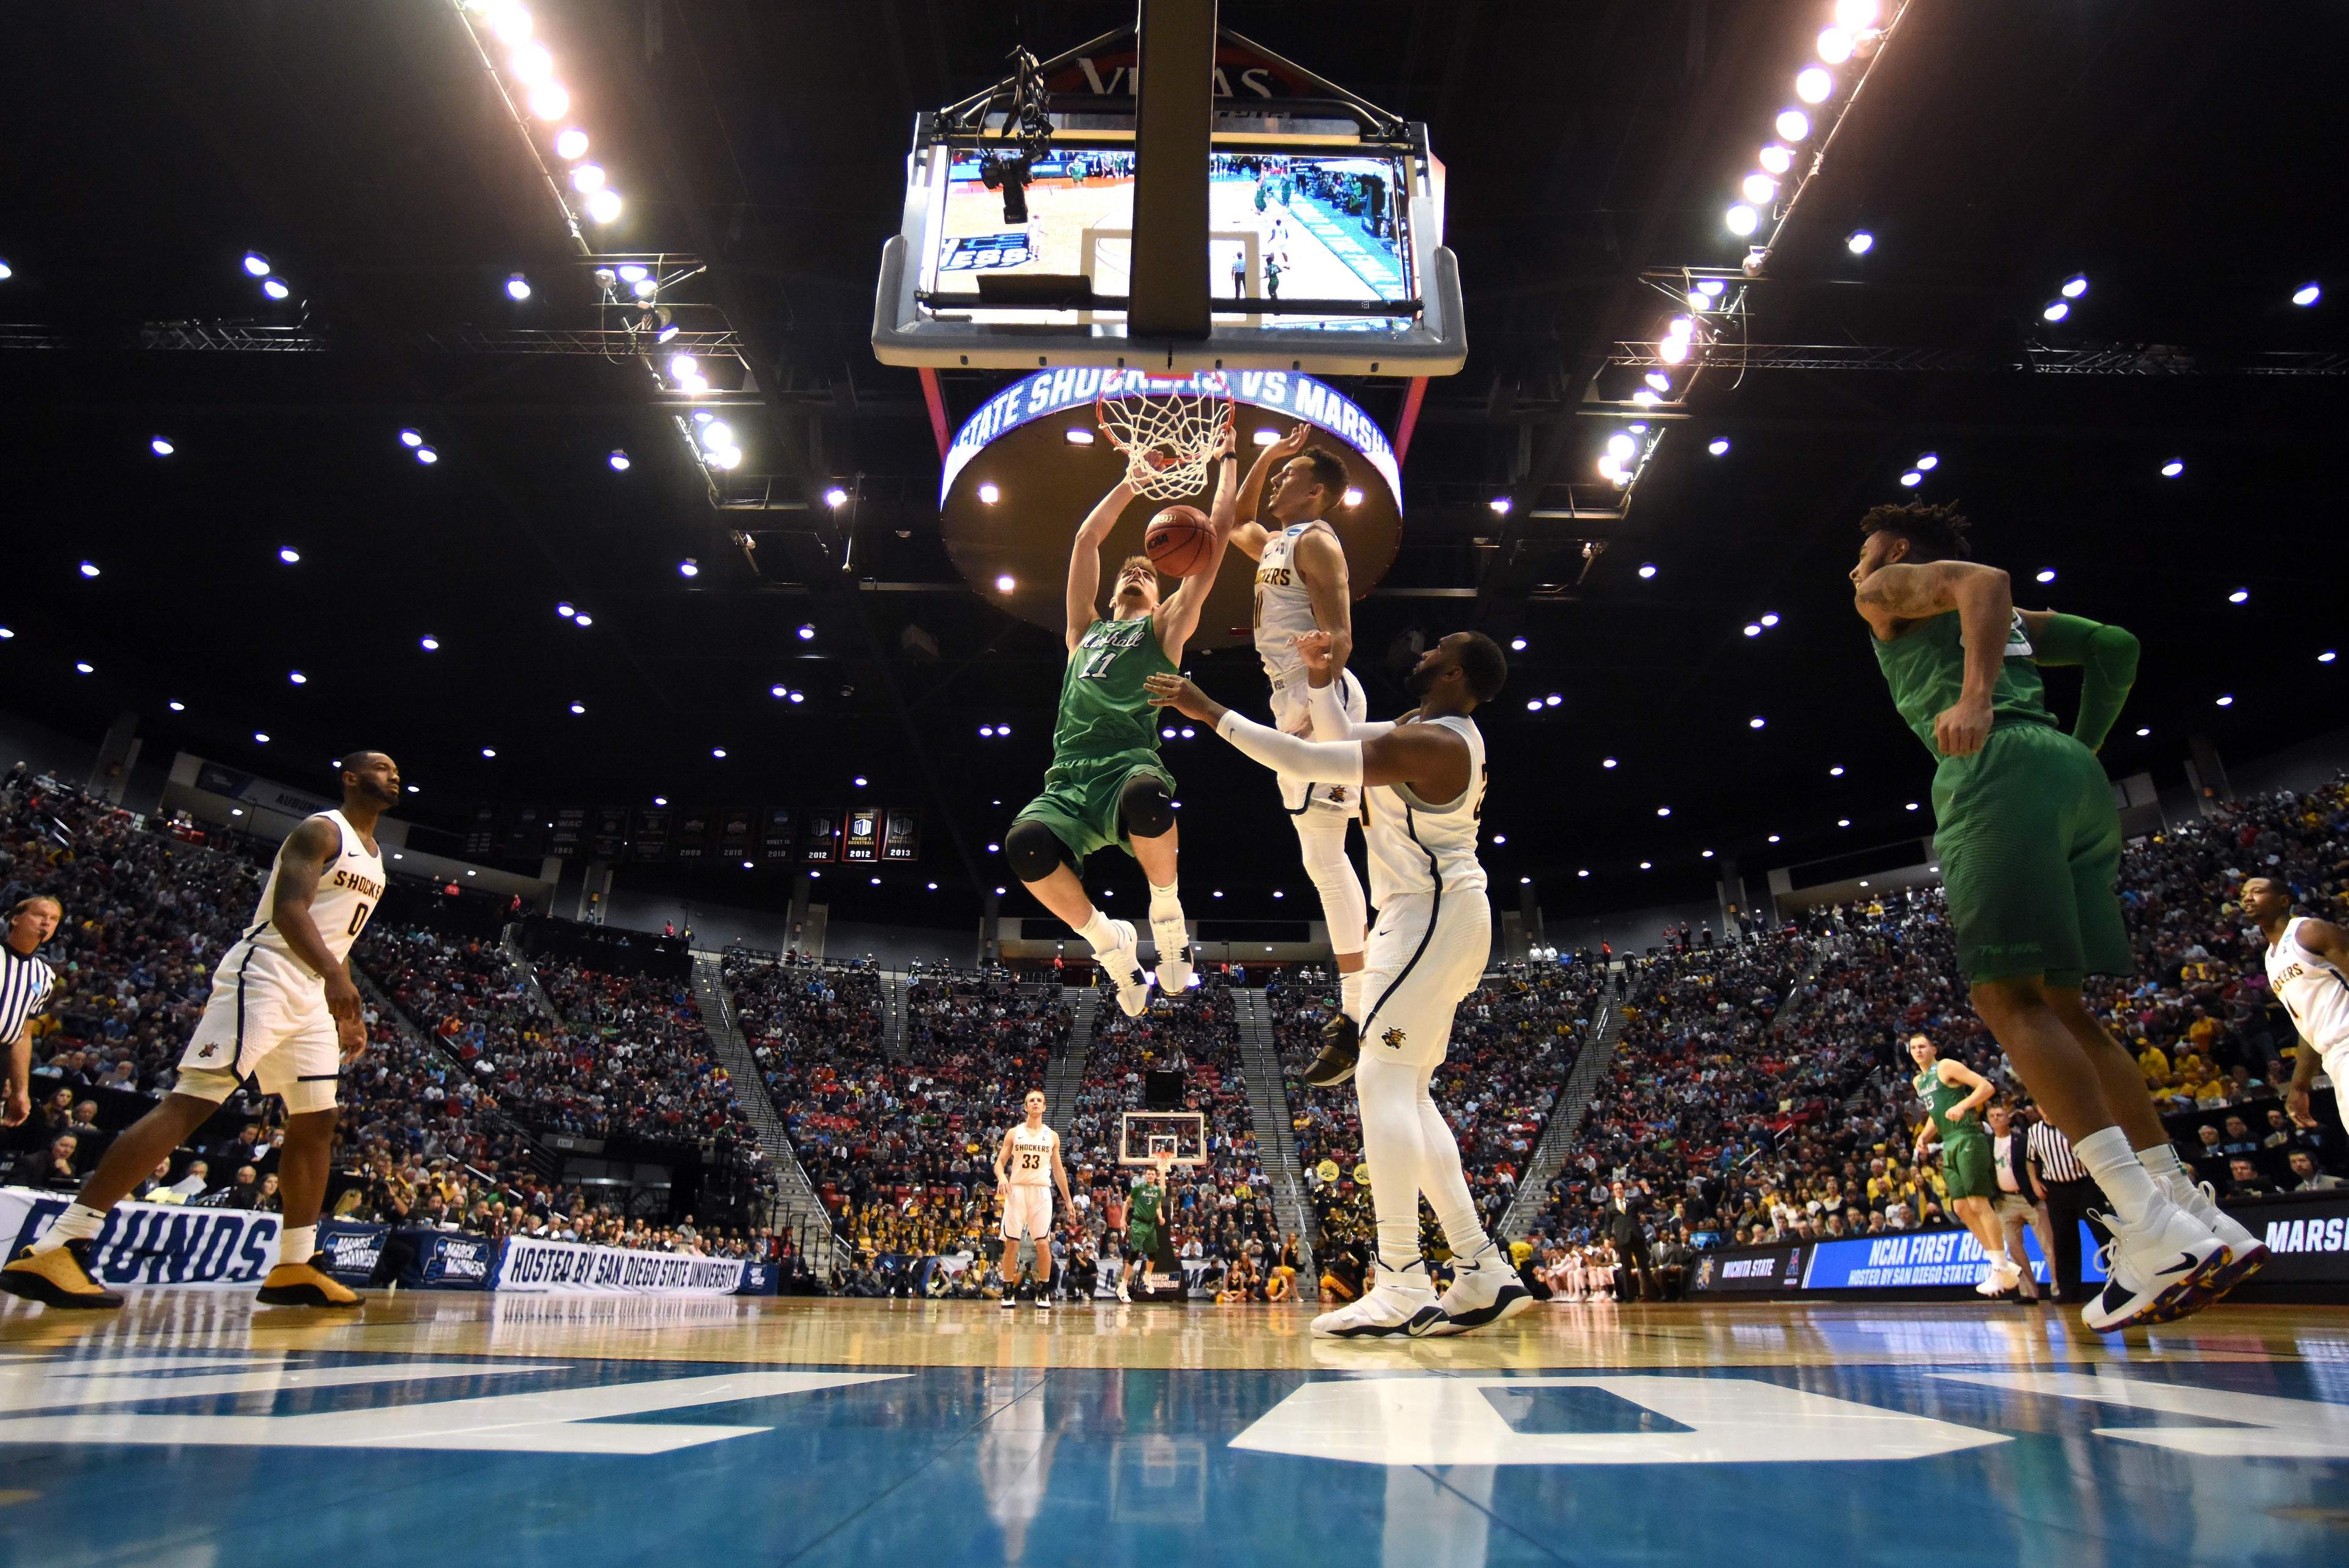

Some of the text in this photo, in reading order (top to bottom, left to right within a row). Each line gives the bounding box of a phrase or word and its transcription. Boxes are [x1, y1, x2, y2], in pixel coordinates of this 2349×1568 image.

[1077, 58, 1271, 98] VIAS
[1242, 371, 1286, 403] VS
[1295, 378, 1392, 456] MARSH
[1078, 652, 1117, 679] 11
[333, 869, 384, 901] SHOCKE
[347, 902, 368, 936] 0
[1015, 1143, 1050, 1153] SHOCKERS
[1022, 1154, 1040, 1170] 33
[1868, 1238, 1909, 1266] NCAA
[1908, 1233, 1958, 1265] FIRST
[510, 1247, 574, 1283] HOSTED
[571, 1252, 597, 1283] BY
[595, 1254, 625, 1285] SAN
[623, 1256, 661, 1287] DIEGO
[659, 1259, 689, 1287] STATE
[688, 1261, 740, 1289] UNIVERSITY
[1751, 1258, 1775, 1277] STATE
[1847, 1268, 1880, 1285] HOSTED
[1880, 1267, 1893, 1285] BY
[1891, 1266, 1912, 1284] SAN
[1911, 1265, 1943, 1284] DIEGO
[1942, 1263, 1974, 1283] STATE
